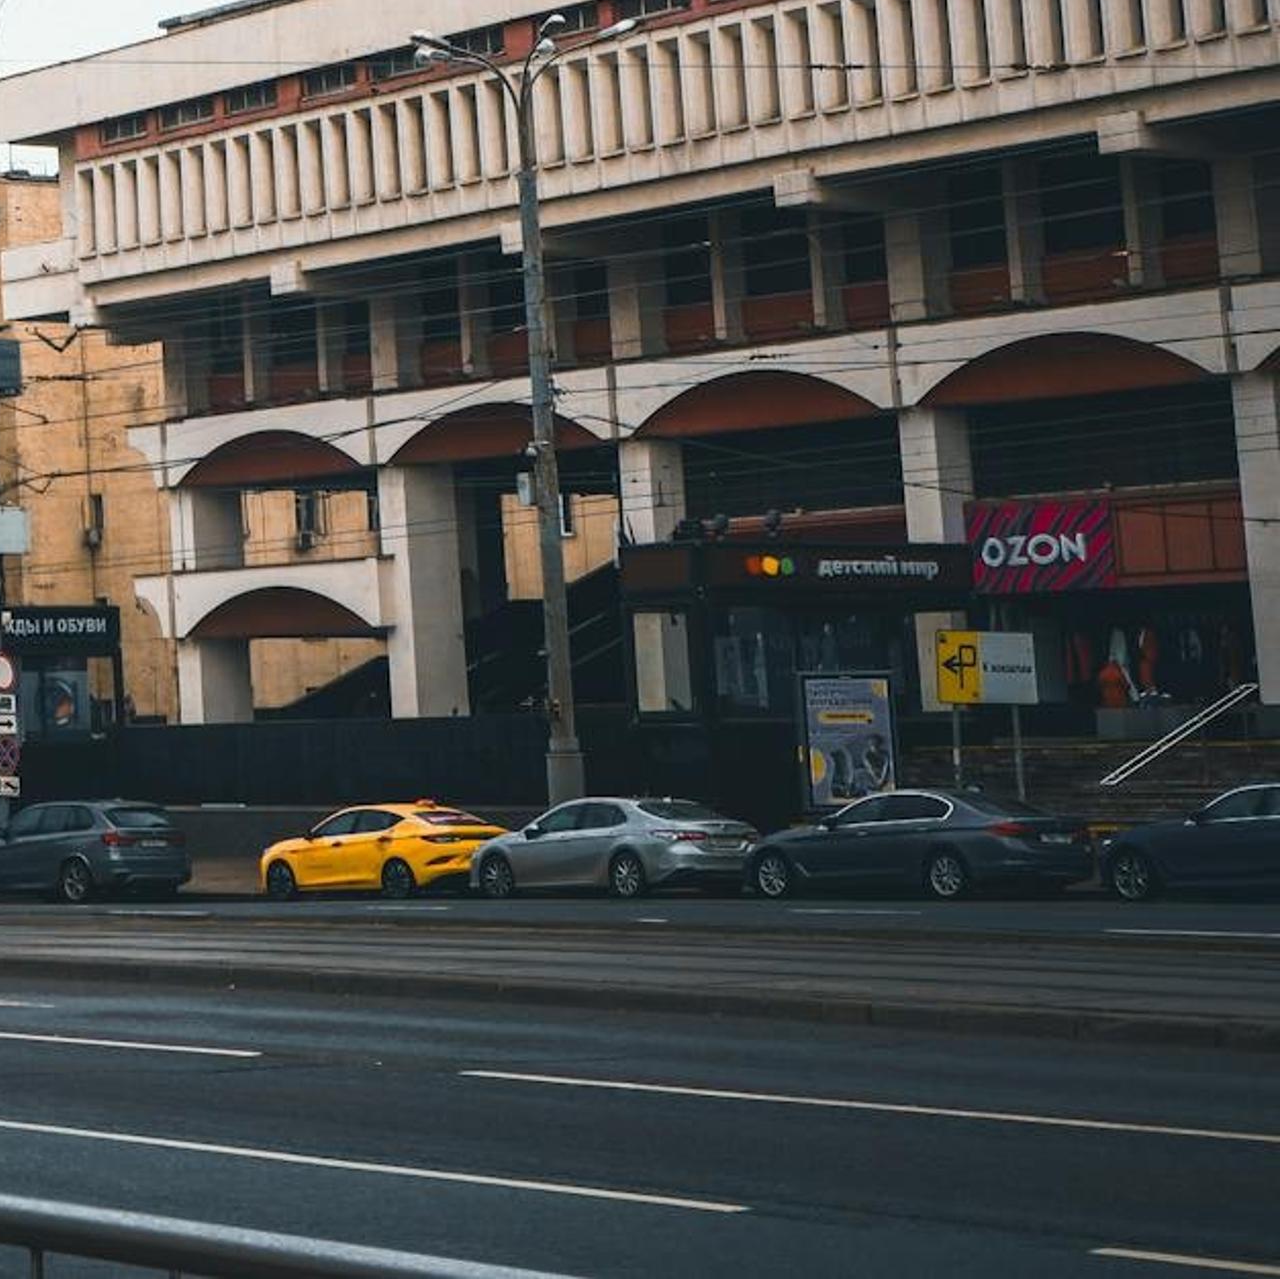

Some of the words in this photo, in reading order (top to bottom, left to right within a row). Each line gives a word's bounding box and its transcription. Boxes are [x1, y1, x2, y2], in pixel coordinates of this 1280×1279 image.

[981, 532, 1086, 568] OZON
[818, 554, 899, 577] детский
[900, 561, 939, 581] мир
[43, 618, 54, 634] И
[57, 617, 107, 633] ОБУВИ
